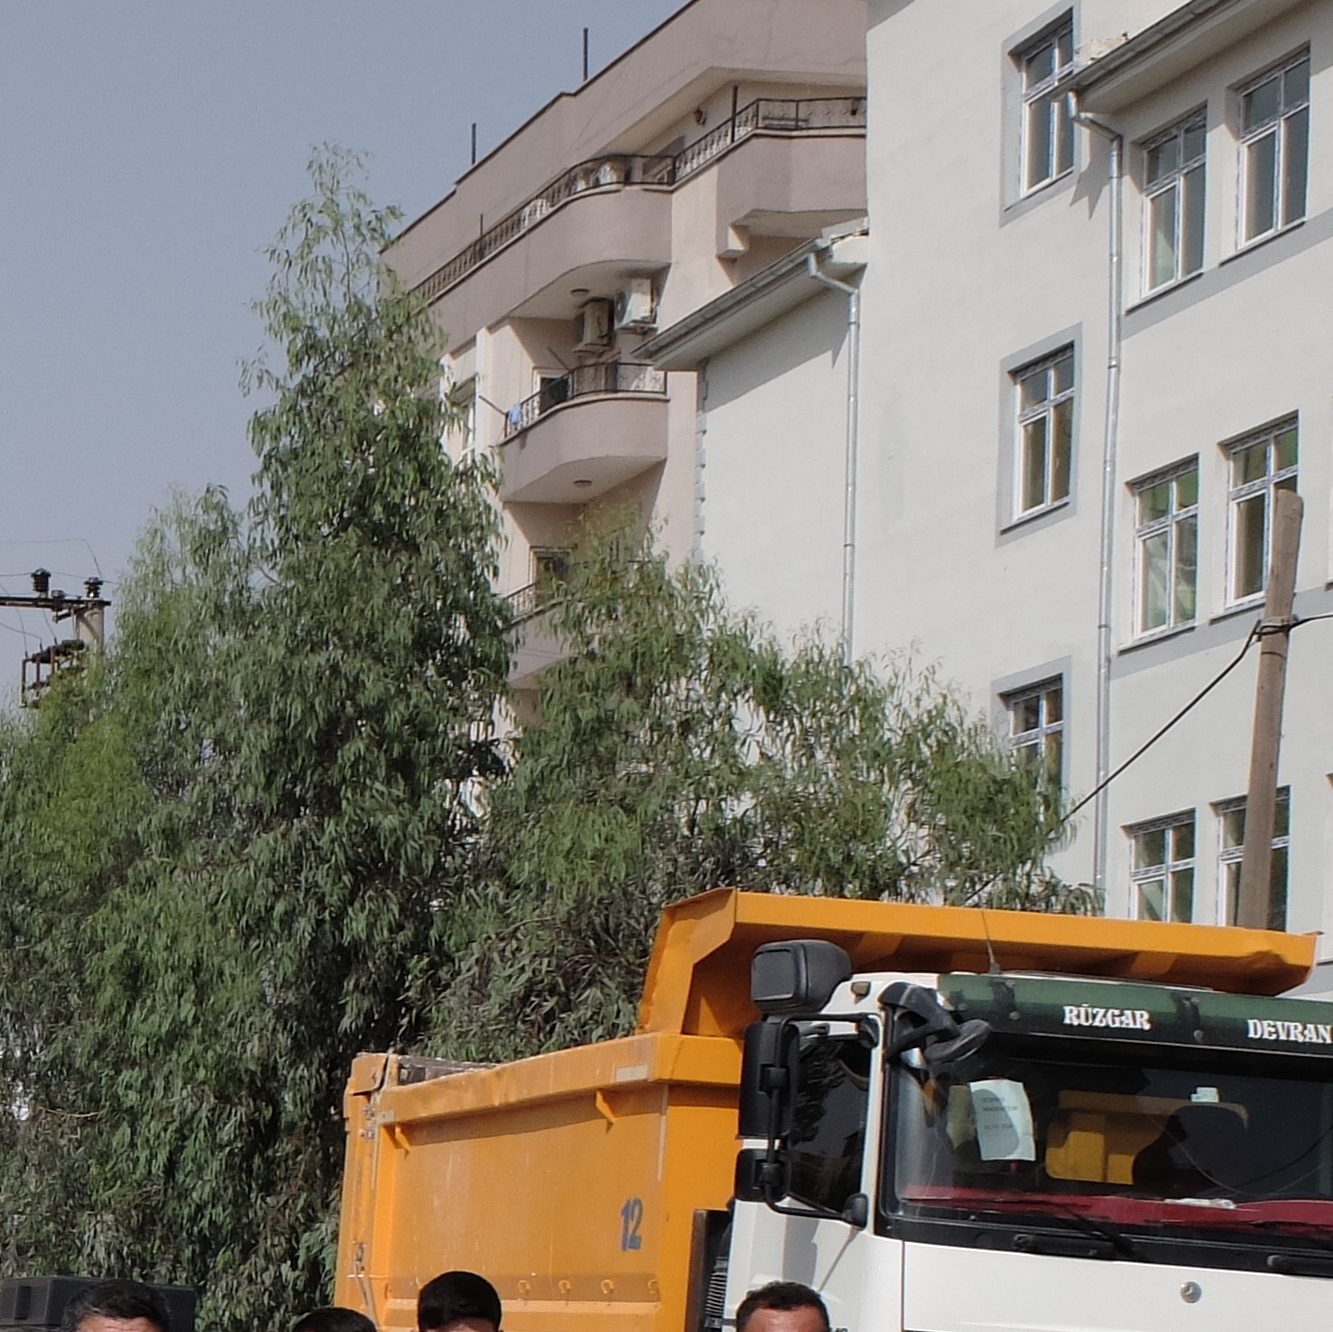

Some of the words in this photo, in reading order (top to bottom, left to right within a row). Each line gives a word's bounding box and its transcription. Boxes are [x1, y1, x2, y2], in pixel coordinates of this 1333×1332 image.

[1062, 1003, 1152, 1031] RÜZGAR
[1246, 1018, 1333, 1044] DEVRAN
[620, 1197, 643, 1253] 12
